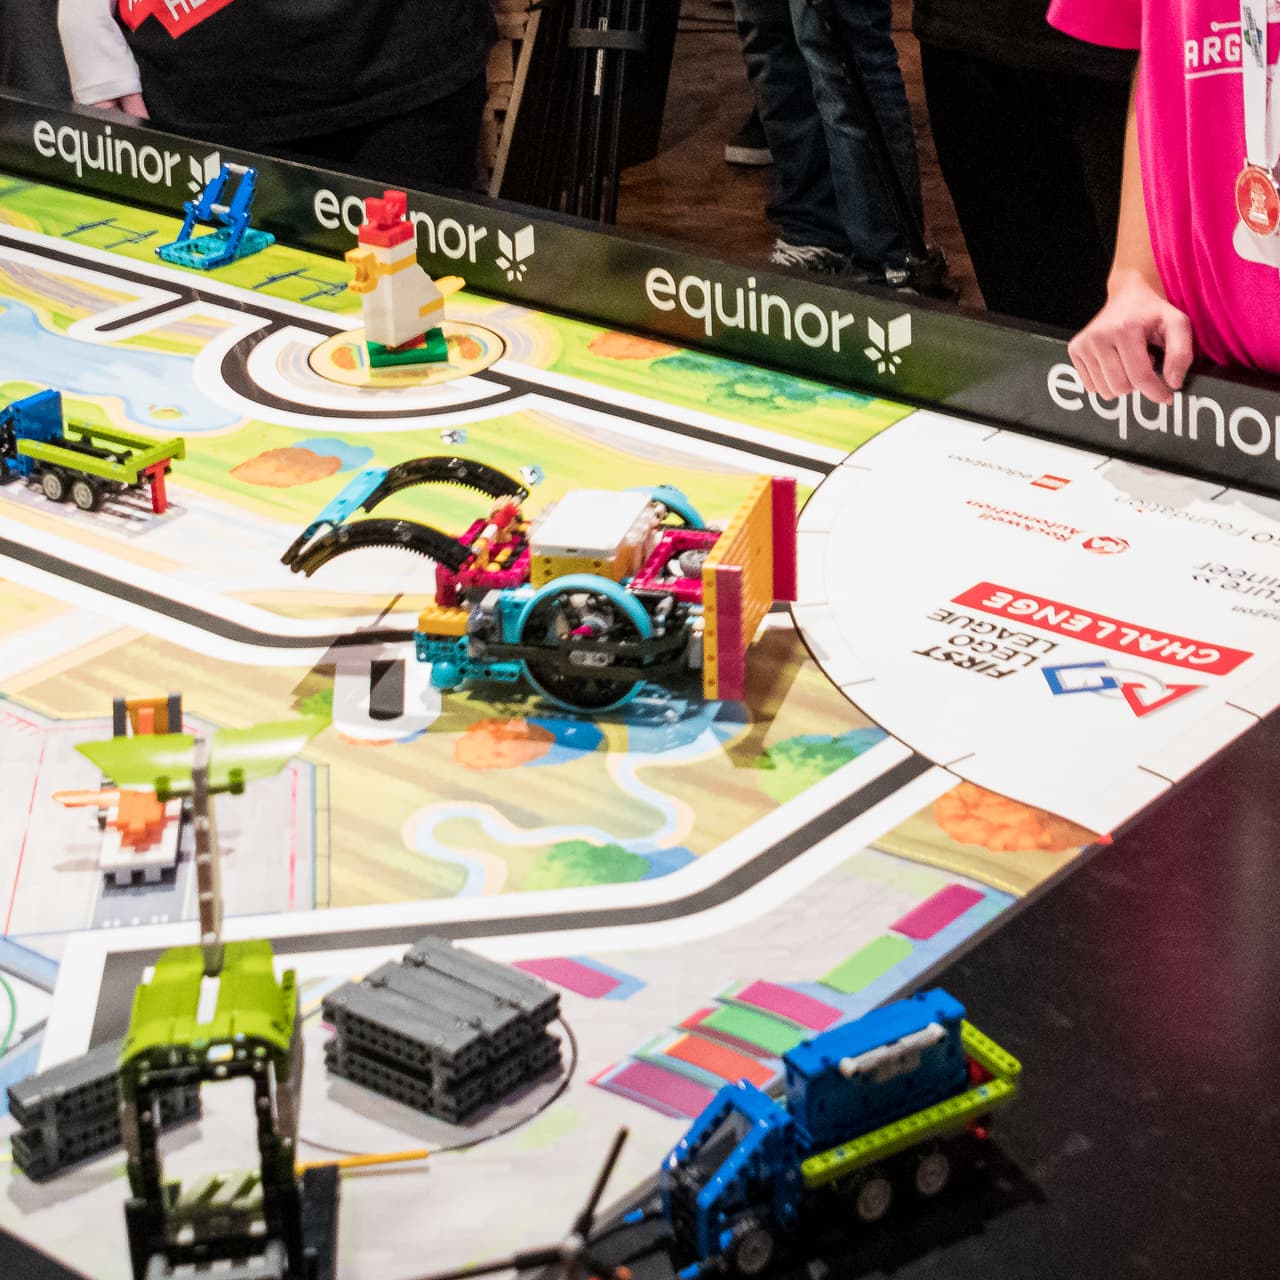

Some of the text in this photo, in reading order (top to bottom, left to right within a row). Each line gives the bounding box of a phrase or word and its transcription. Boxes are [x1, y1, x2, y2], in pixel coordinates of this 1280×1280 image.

[1185, 33, 1241, 68] ARG
[33, 119, 181, 187] equinor
[645, 267, 855, 353] equinor
[978, 512, 1071, 543] Rockwell
[926, 607, 1059, 654] LEAGUE
[982, 590, 1221, 665] CHALLENGE
[912, 645, 1019, 680] FIRST
[947, 633, 1040, 668] LEGO
